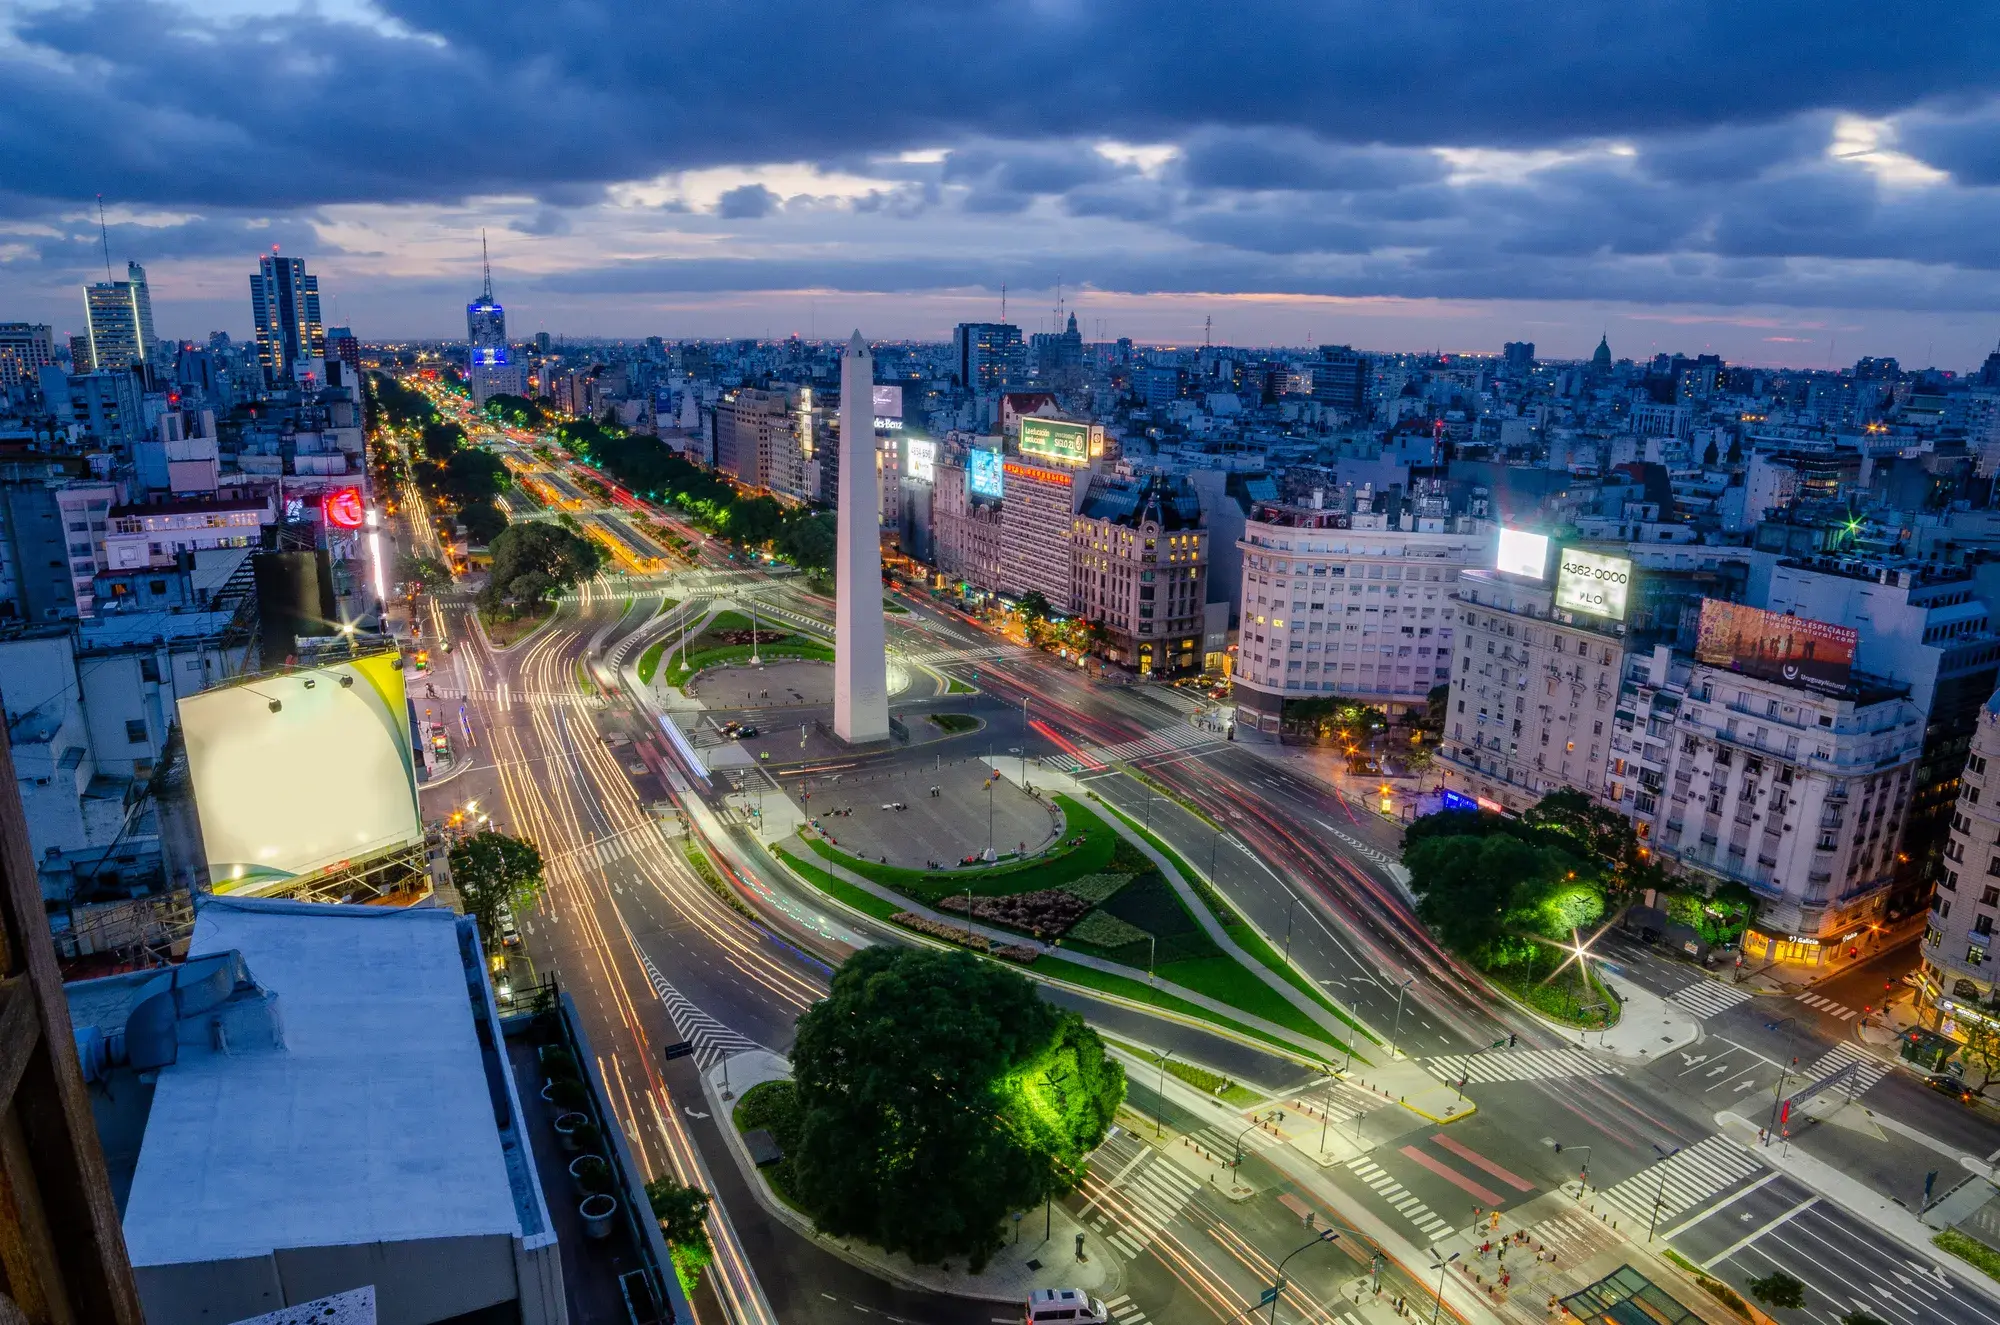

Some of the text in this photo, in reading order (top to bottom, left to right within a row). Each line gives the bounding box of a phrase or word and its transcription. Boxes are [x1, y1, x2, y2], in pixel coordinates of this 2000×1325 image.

[1054, 439, 1074, 449] SIGLO 21
[1563, 563, 1627, 584] 4362-0000
[1808, 622, 1856, 638] ESPECIALES
[1801, 674, 1847, 690] UruguayNatural
